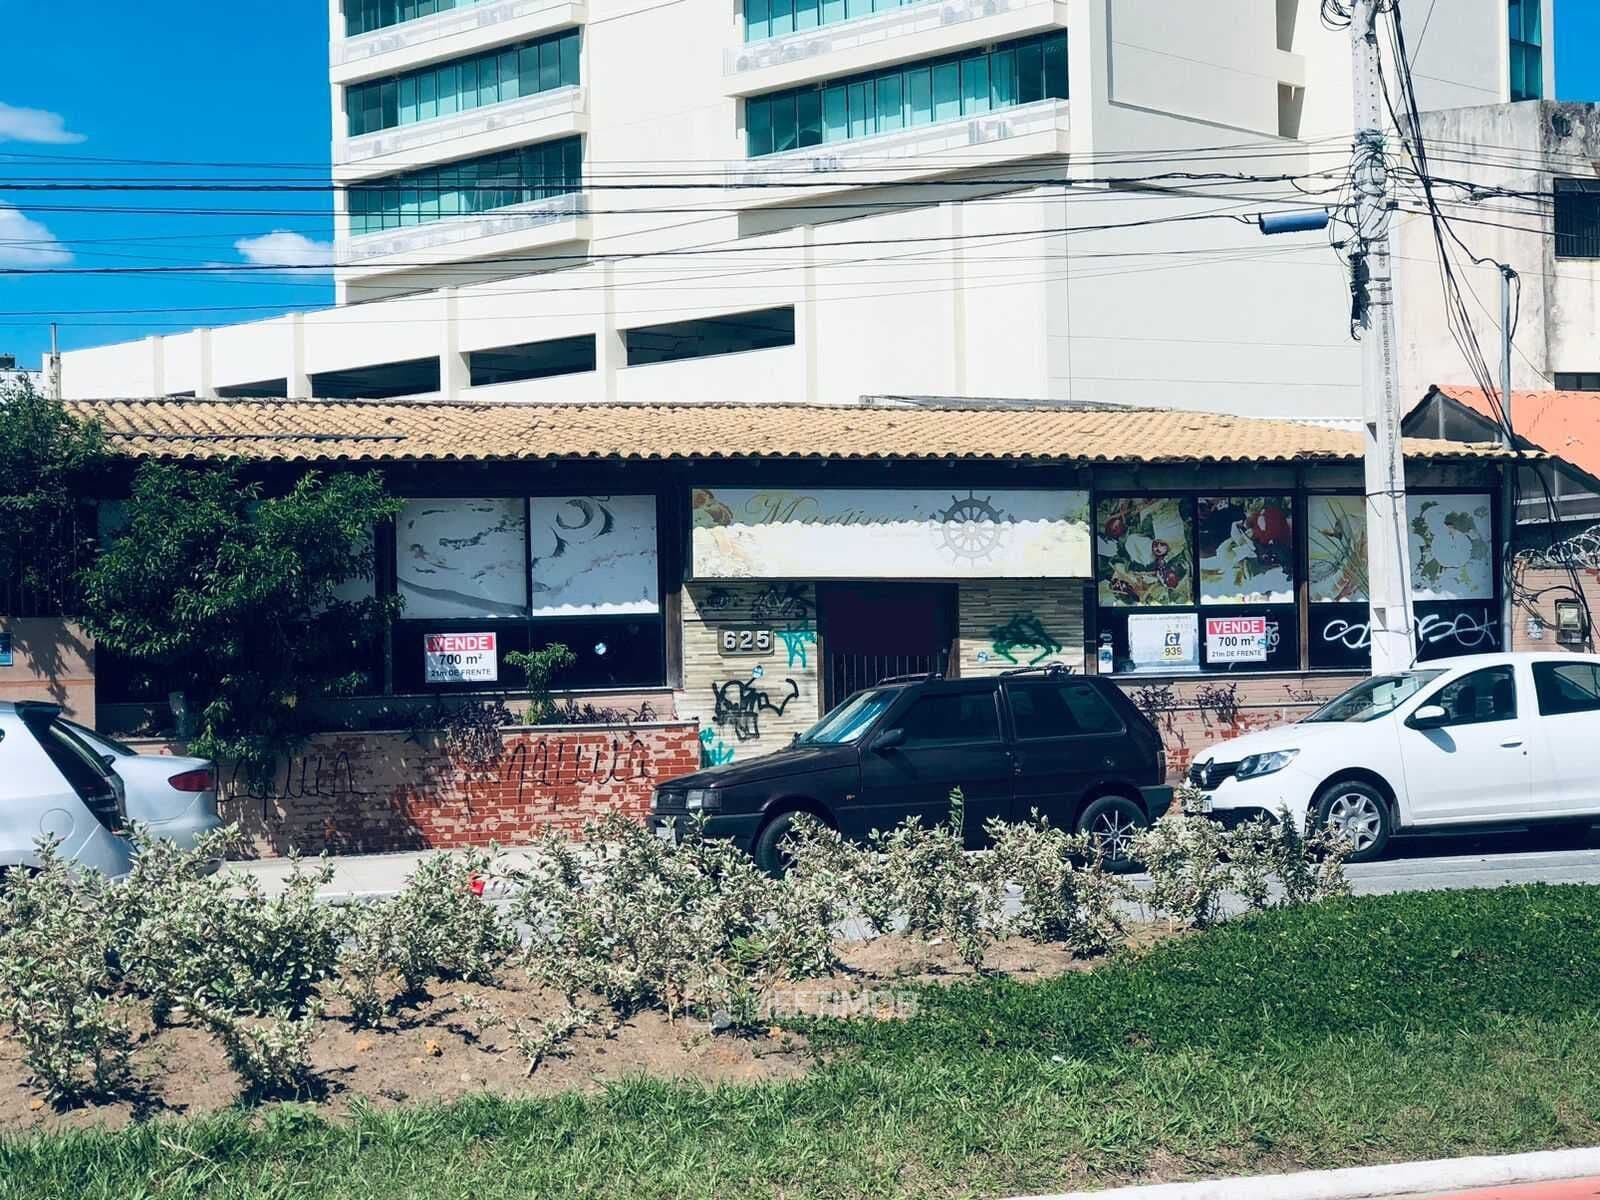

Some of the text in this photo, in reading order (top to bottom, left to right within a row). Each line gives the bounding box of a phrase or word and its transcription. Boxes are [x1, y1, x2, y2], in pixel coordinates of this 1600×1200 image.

[1213, 620, 1260, 634] VENDE
[433, 636, 489, 650] VENDE
[723, 630, 770, 649] 625
[1218, 636, 1238, 647] 700
[1236, 649, 1262, 657] FRENTE
[439, 654, 462, 665] 700
[448, 669, 460, 677] DE
[460, 668, 492, 676] FRENTE
